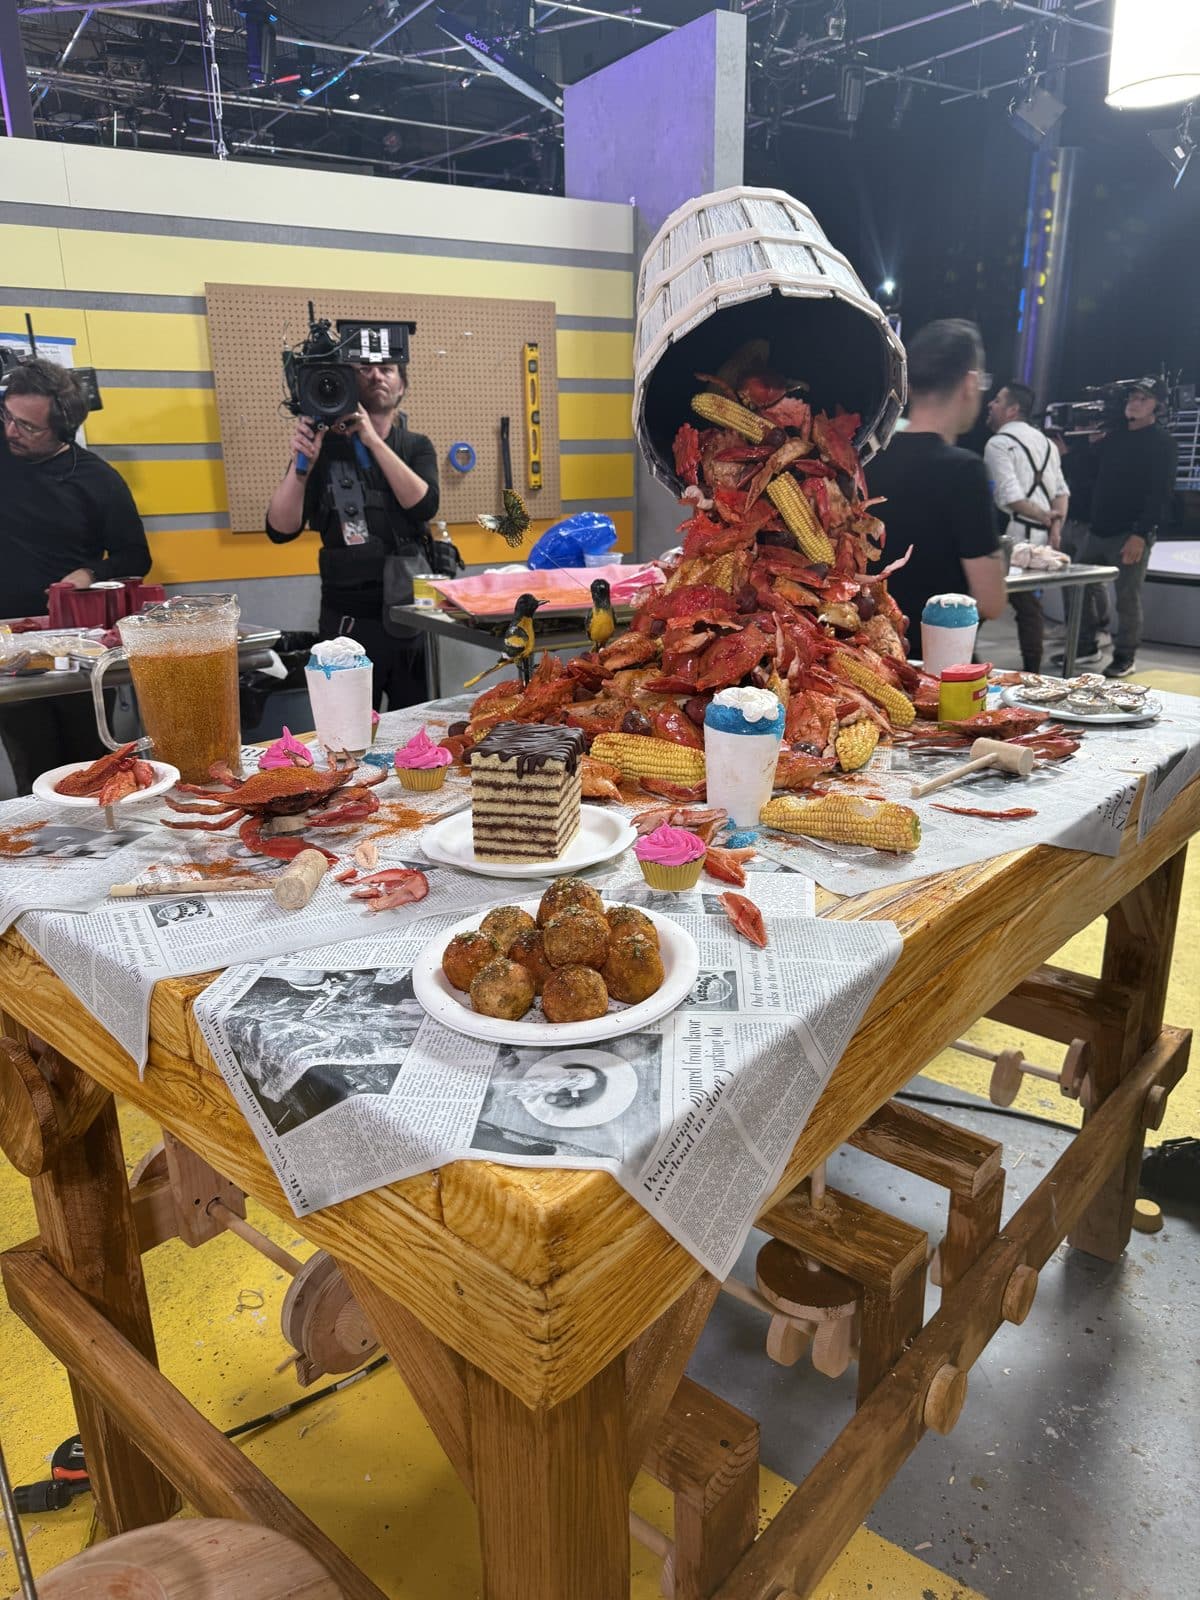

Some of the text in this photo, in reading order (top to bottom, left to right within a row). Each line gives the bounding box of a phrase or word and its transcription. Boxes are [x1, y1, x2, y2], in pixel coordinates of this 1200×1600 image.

[465, 33, 490, 53] Godox
[765, 973, 777, 981] the
[750, 993, 764, 1007] Owl
[766, 992, 781, 1007] licks
[682, 1020, 701, 1041] flavor
[223, 1049, 240, 1078] keep
[682, 1046, 701, 1064] from
[239, 1079, 262, 1119] shapes
[654, 1027, 733, 1202] overload in store parking lot
[261, 1121, 274, 1138] ice
[273, 1143, 288, 1170] New
[643, 1111, 696, 1191] Pedestrian
[290, 1173, 309, 1208] BAR:
